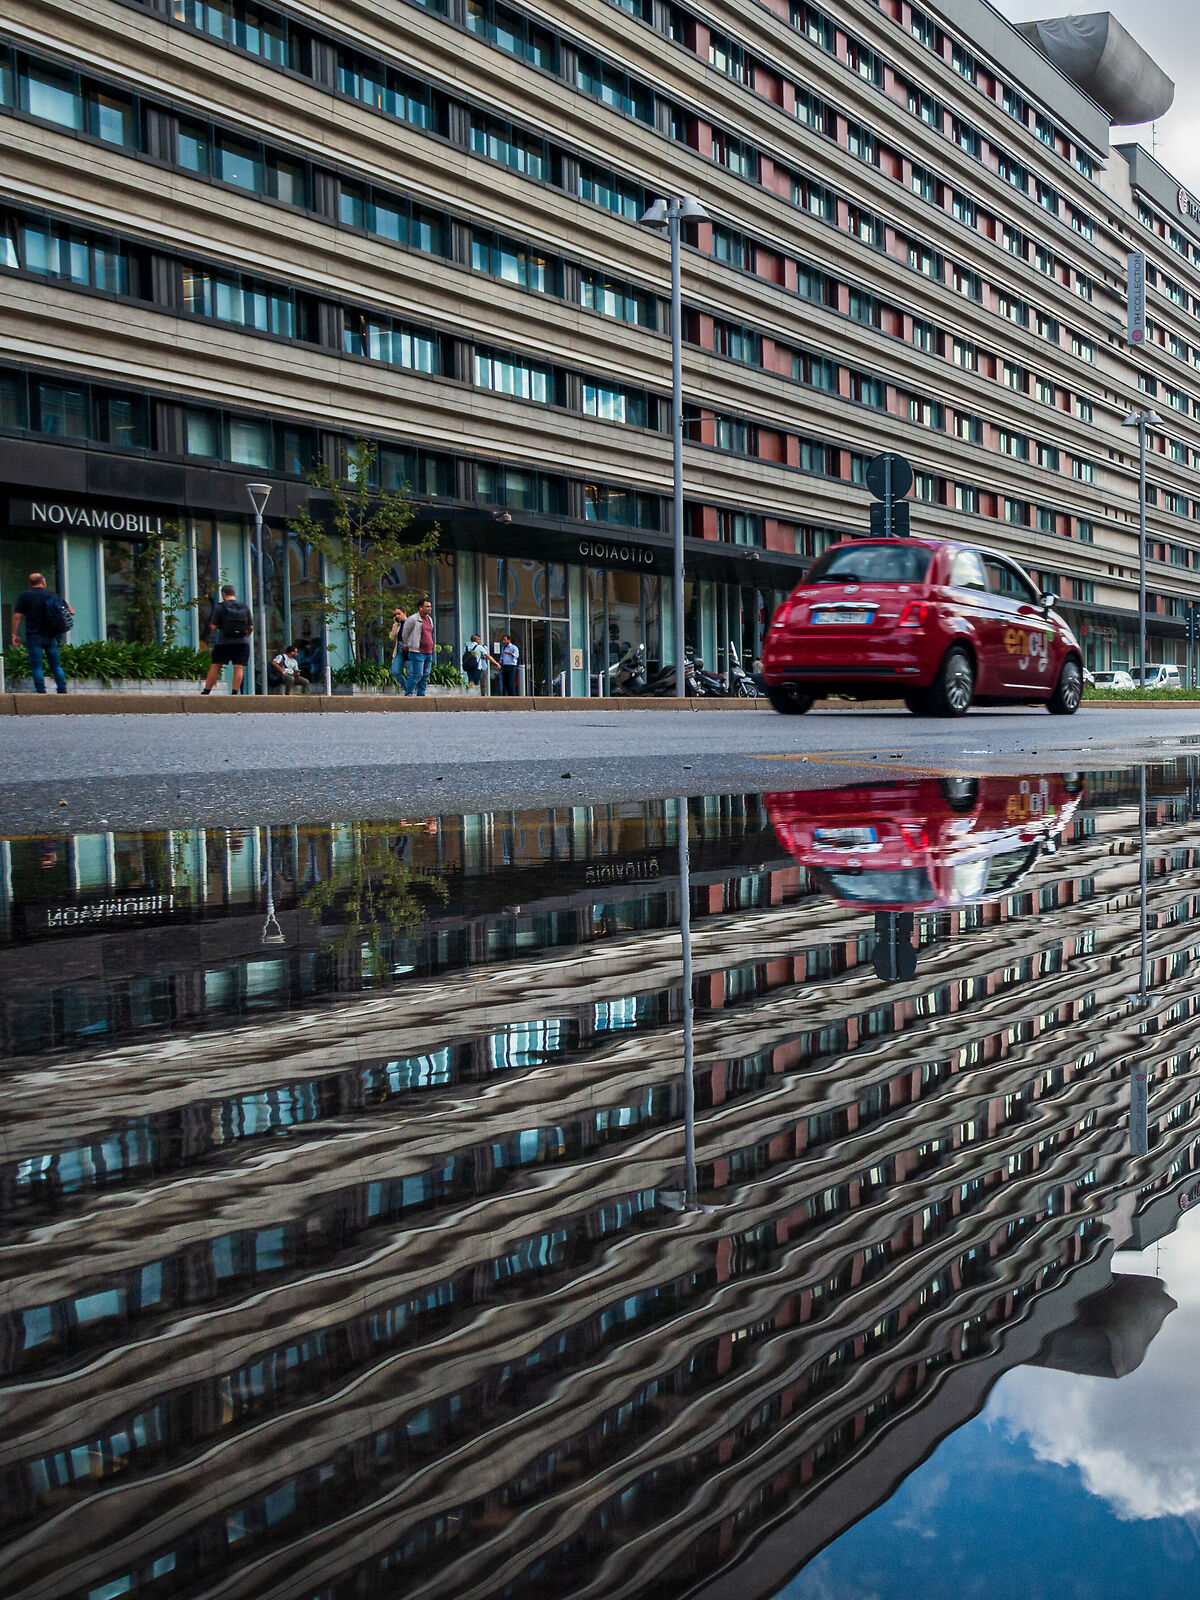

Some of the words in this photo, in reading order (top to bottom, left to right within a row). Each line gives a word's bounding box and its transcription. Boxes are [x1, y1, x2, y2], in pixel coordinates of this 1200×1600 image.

[1134, 255, 1142, 311] COLLECTION
[32, 502, 162, 534] NOVAMOBILI
[579, 540, 654, 564] GIOIAOTTO
[574, 655, 580, 668] 8
[1004, 629, 1048, 672] enjoy
